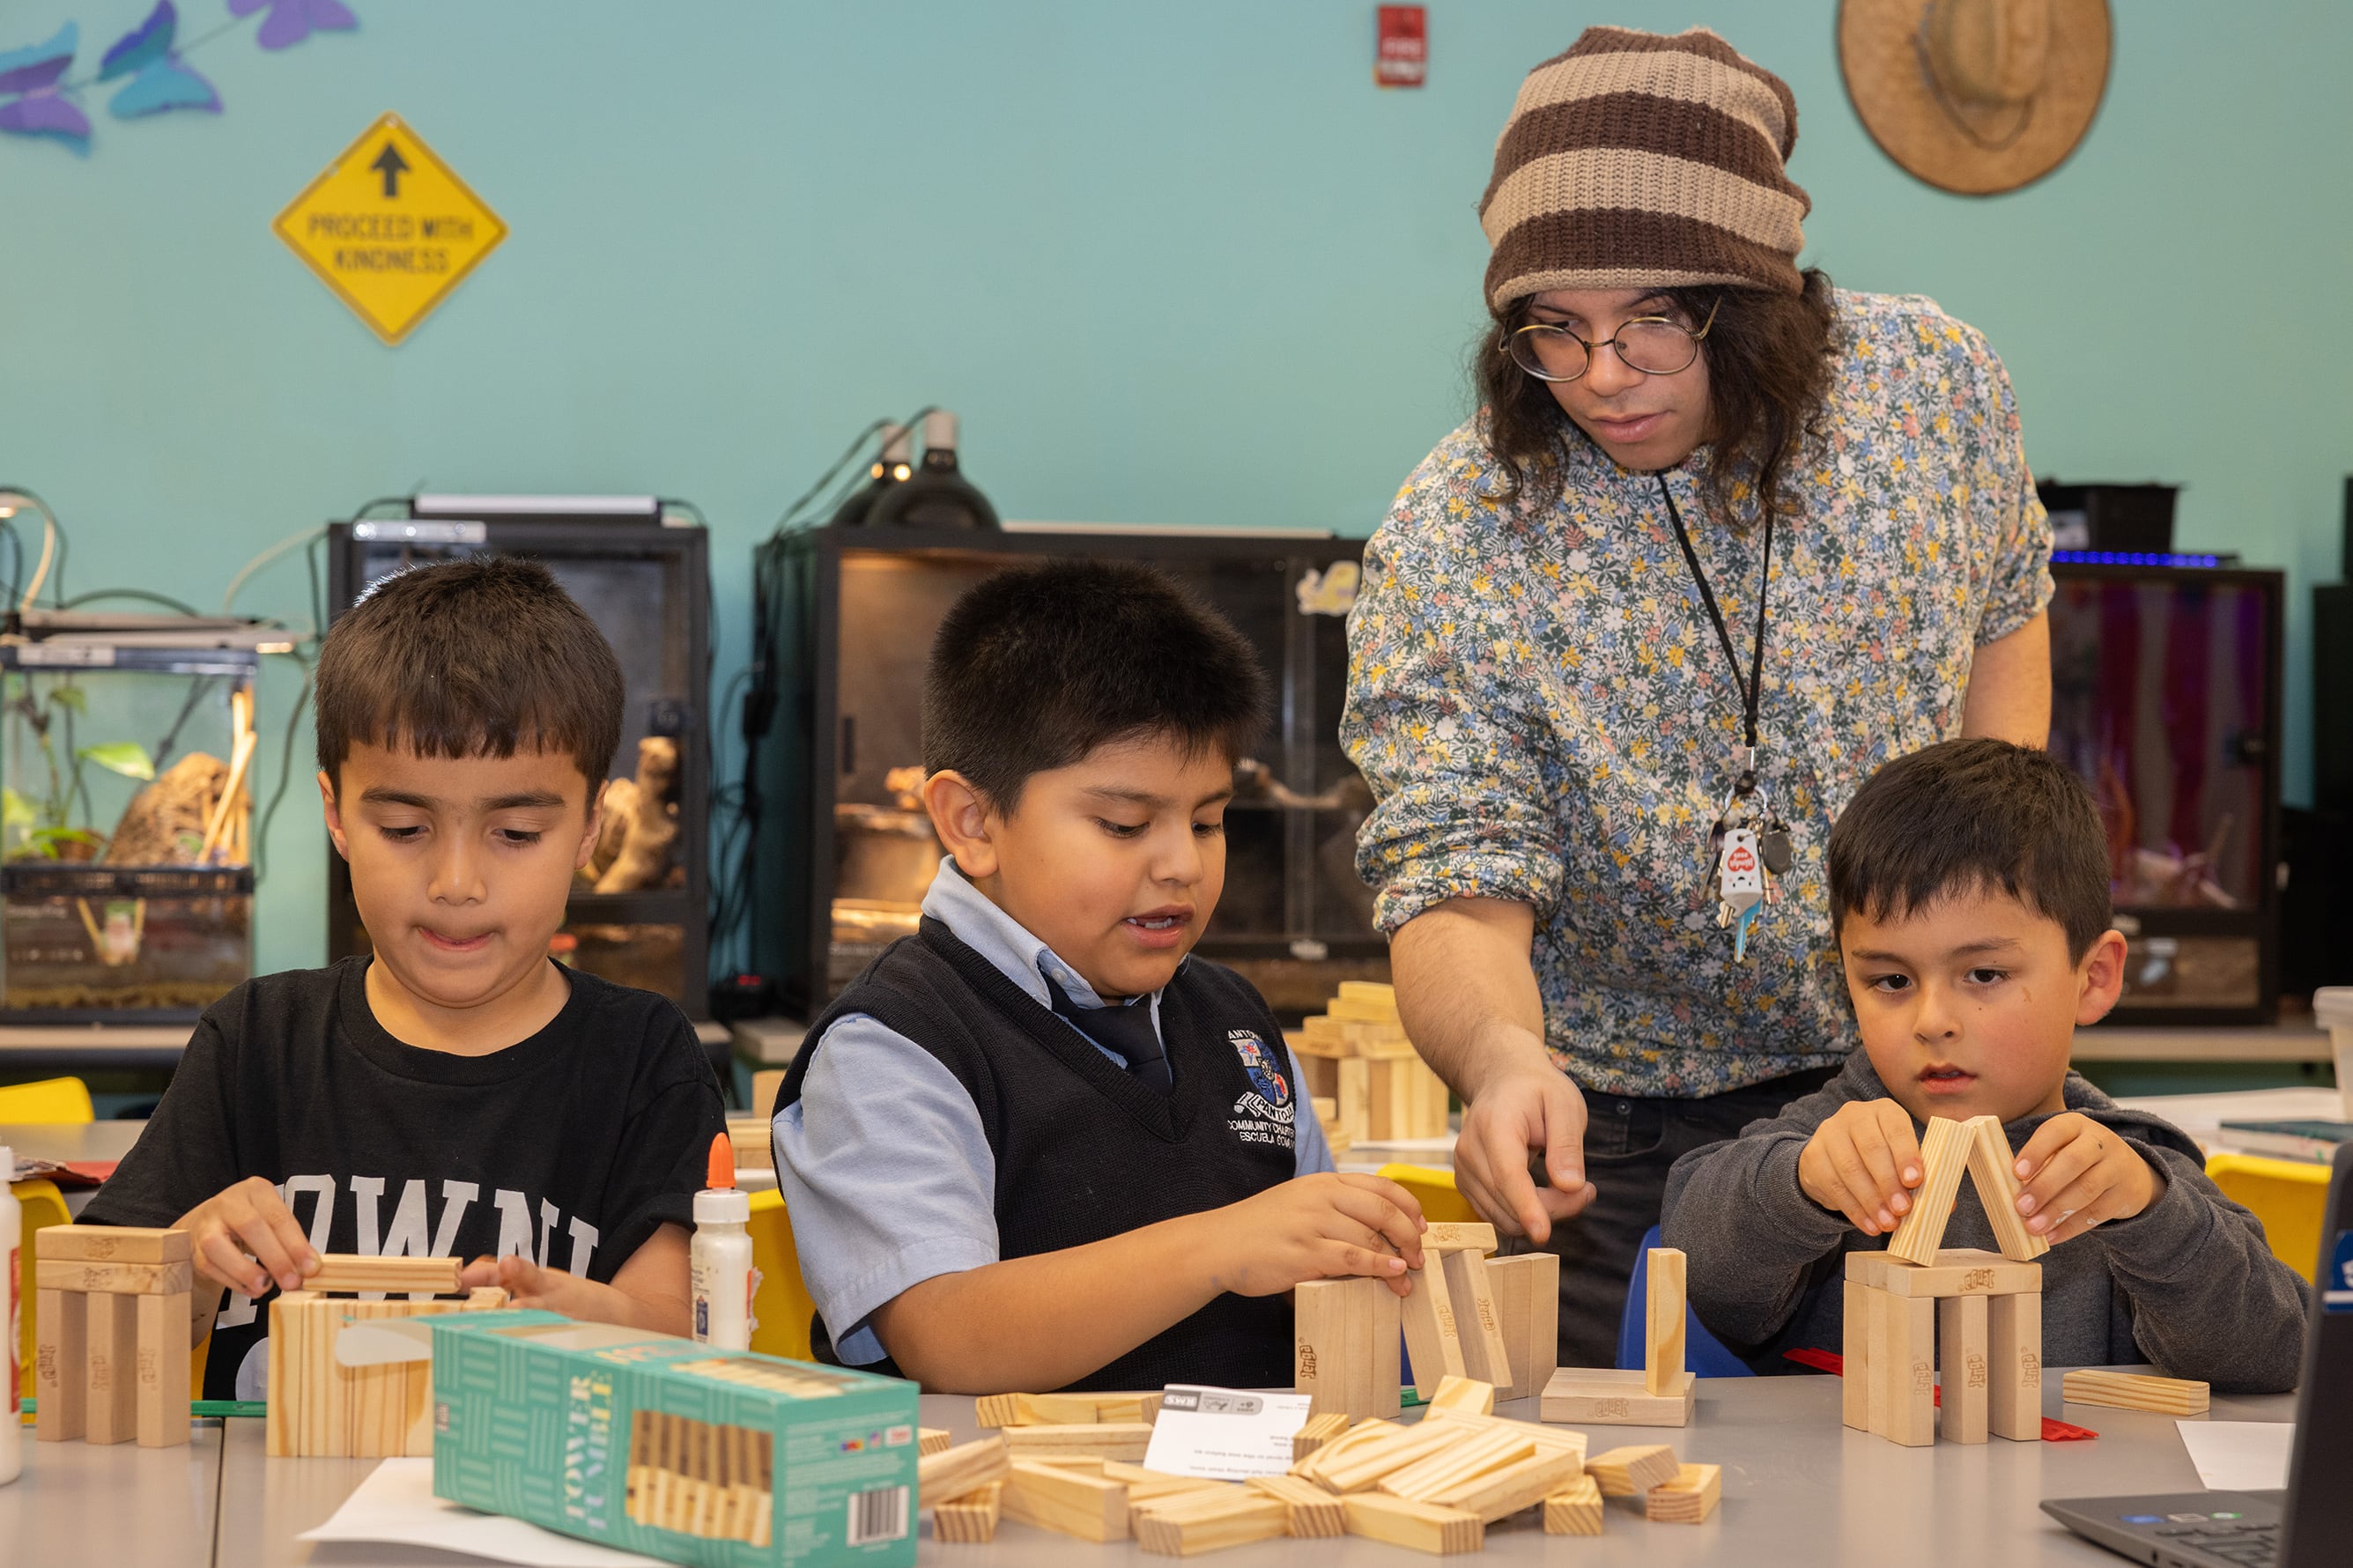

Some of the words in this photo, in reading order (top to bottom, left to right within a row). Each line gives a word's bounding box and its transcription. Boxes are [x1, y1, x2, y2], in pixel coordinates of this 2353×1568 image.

[307, 213, 414, 241] PROCEED
[420, 216, 474, 242] WITH
[333, 247, 450, 275] KINDNESS
[1964, 1268, 1995, 1291] Jenga
[1476, 1298, 1496, 1332] Jenga
[1299, 1344, 1317, 1379] Jenga
[1913, 1361, 1933, 1396] Jenga
[1965, 1353, 1987, 1388] Jenga
[2021, 1353, 2040, 1388] Jenga
